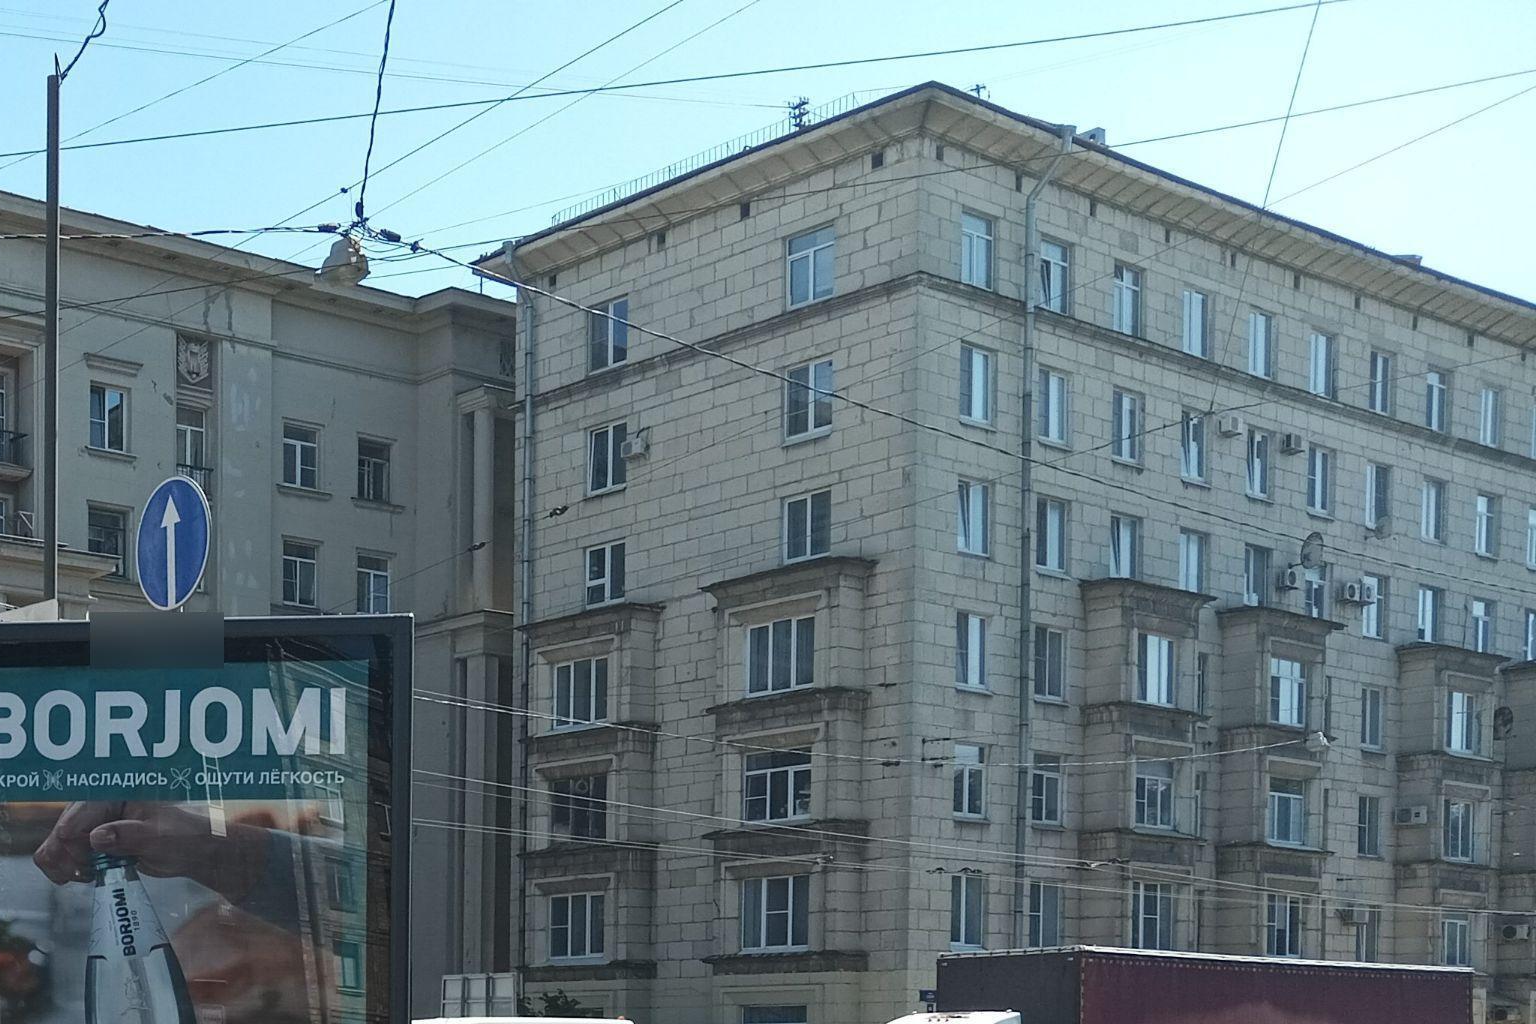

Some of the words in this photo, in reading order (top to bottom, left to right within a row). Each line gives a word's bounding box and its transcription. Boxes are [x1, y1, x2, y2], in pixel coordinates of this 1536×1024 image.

[66, 771, 168, 788] НАСЛАДИСЬ
[195, 771, 255, 787] ОЩУТИ
[259, 767, 345, 786] ЛЁГКОСТЬ
[112, 888, 137, 956] BORJOMI
